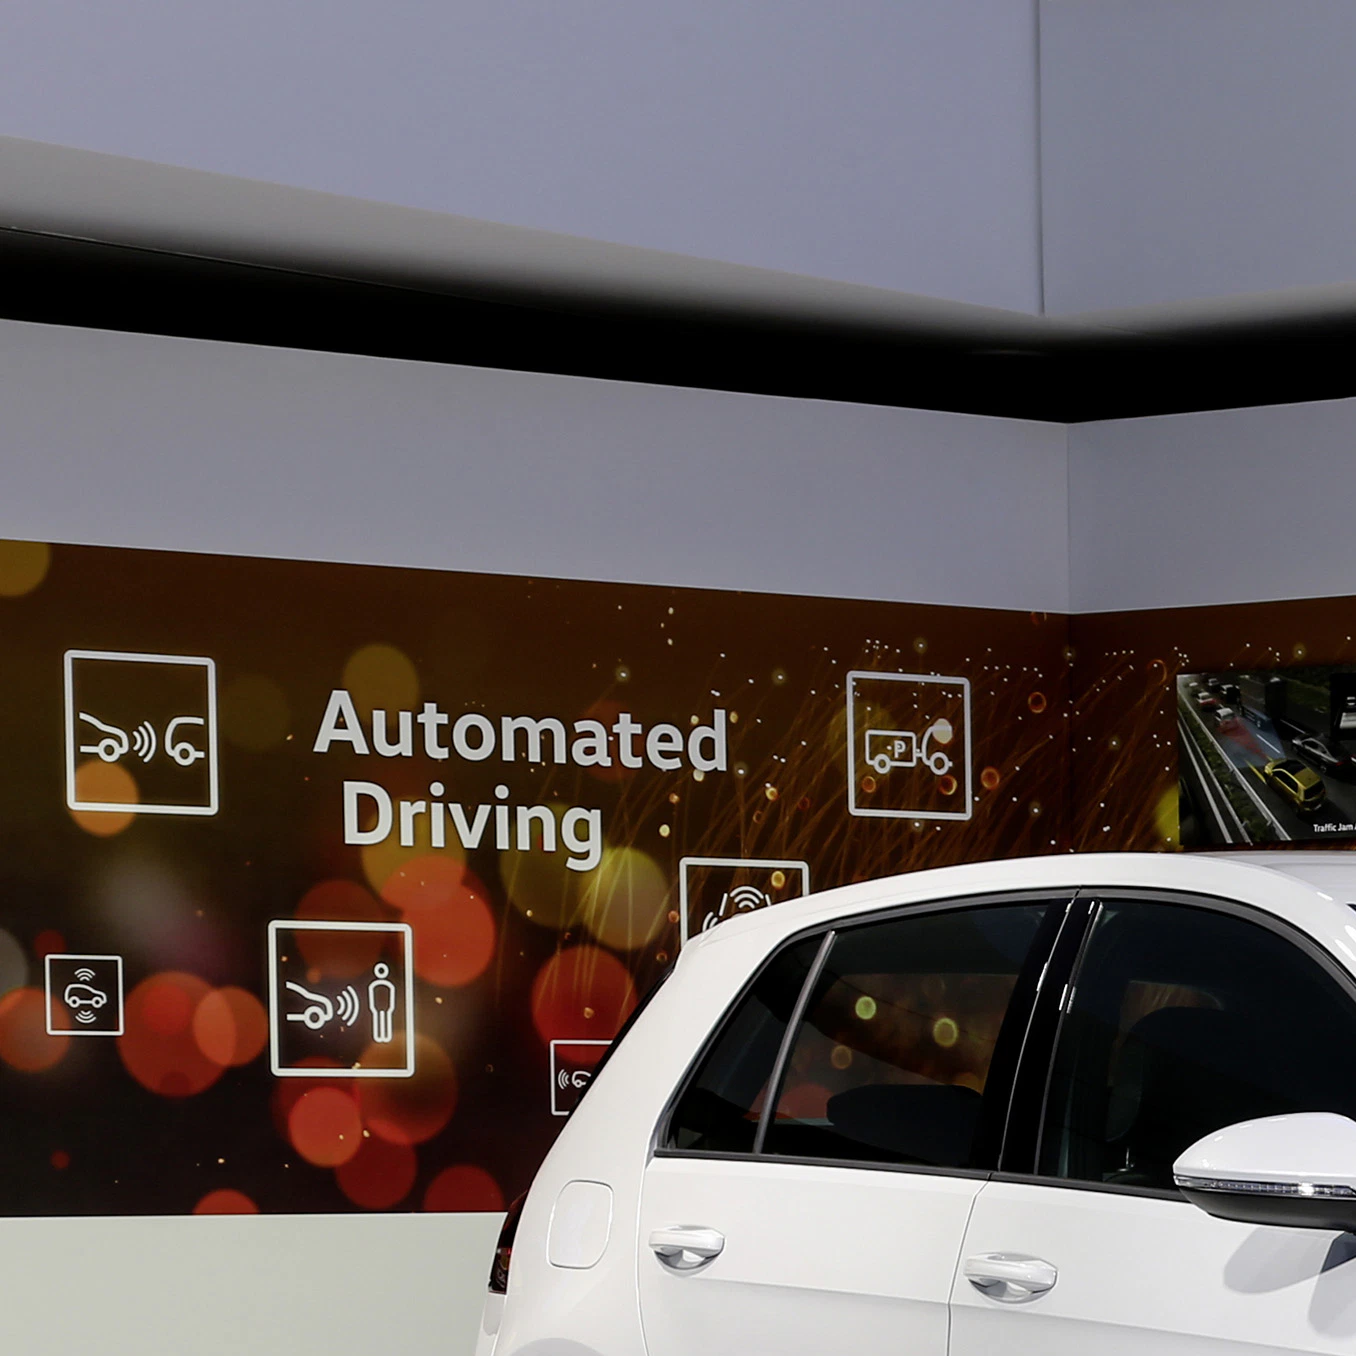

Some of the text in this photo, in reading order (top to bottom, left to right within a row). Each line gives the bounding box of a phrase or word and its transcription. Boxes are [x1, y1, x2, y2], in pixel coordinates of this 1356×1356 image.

[312, 689, 728, 772] Automated
[342, 780, 601, 872] Driving
[1313, 823, 1337, 832] Traffic
[1338, 823, 1353, 831] Jam
